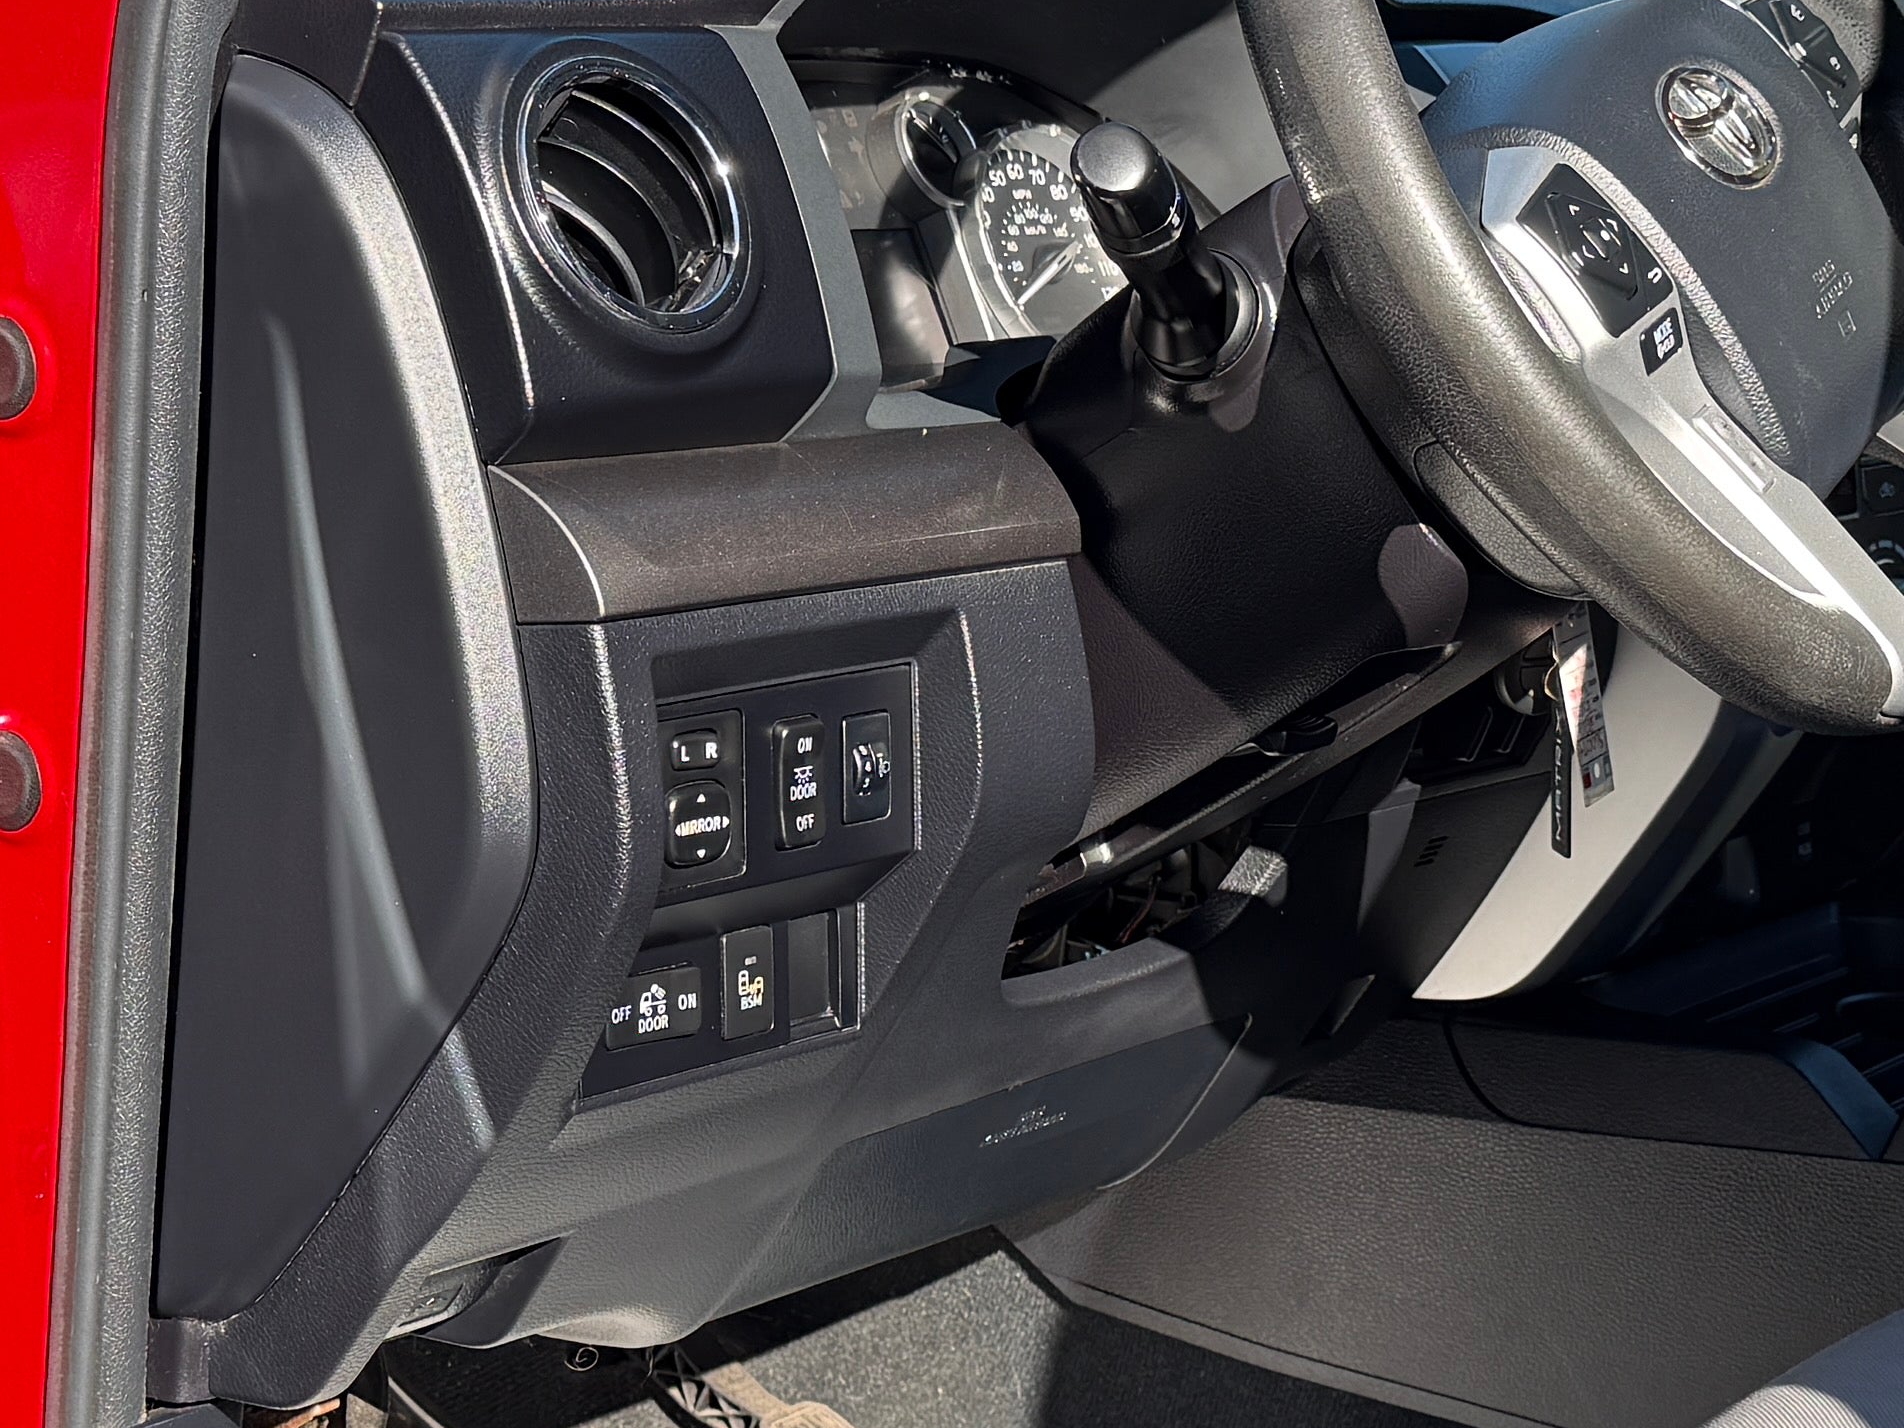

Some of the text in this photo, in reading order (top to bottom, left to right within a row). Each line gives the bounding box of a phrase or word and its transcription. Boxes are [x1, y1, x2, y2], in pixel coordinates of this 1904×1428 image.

[989, 170, 1006, 186] 50
[1006, 163, 1024, 180] 60
[1029, 169, 1046, 185] 70
[1050, 184, 1068, 201] 80
[680, 742, 718, 762] L R
[798, 737, 813, 754] ON
[790, 782, 817, 802] DOOR
[796, 814, 815, 832] OFF
[678, 993, 696, 1011] ON
[740, 994, 764, 1011] BSM
[611, 1005, 632, 1024] OFF
[638, 1015, 669, 1034] DOOR
